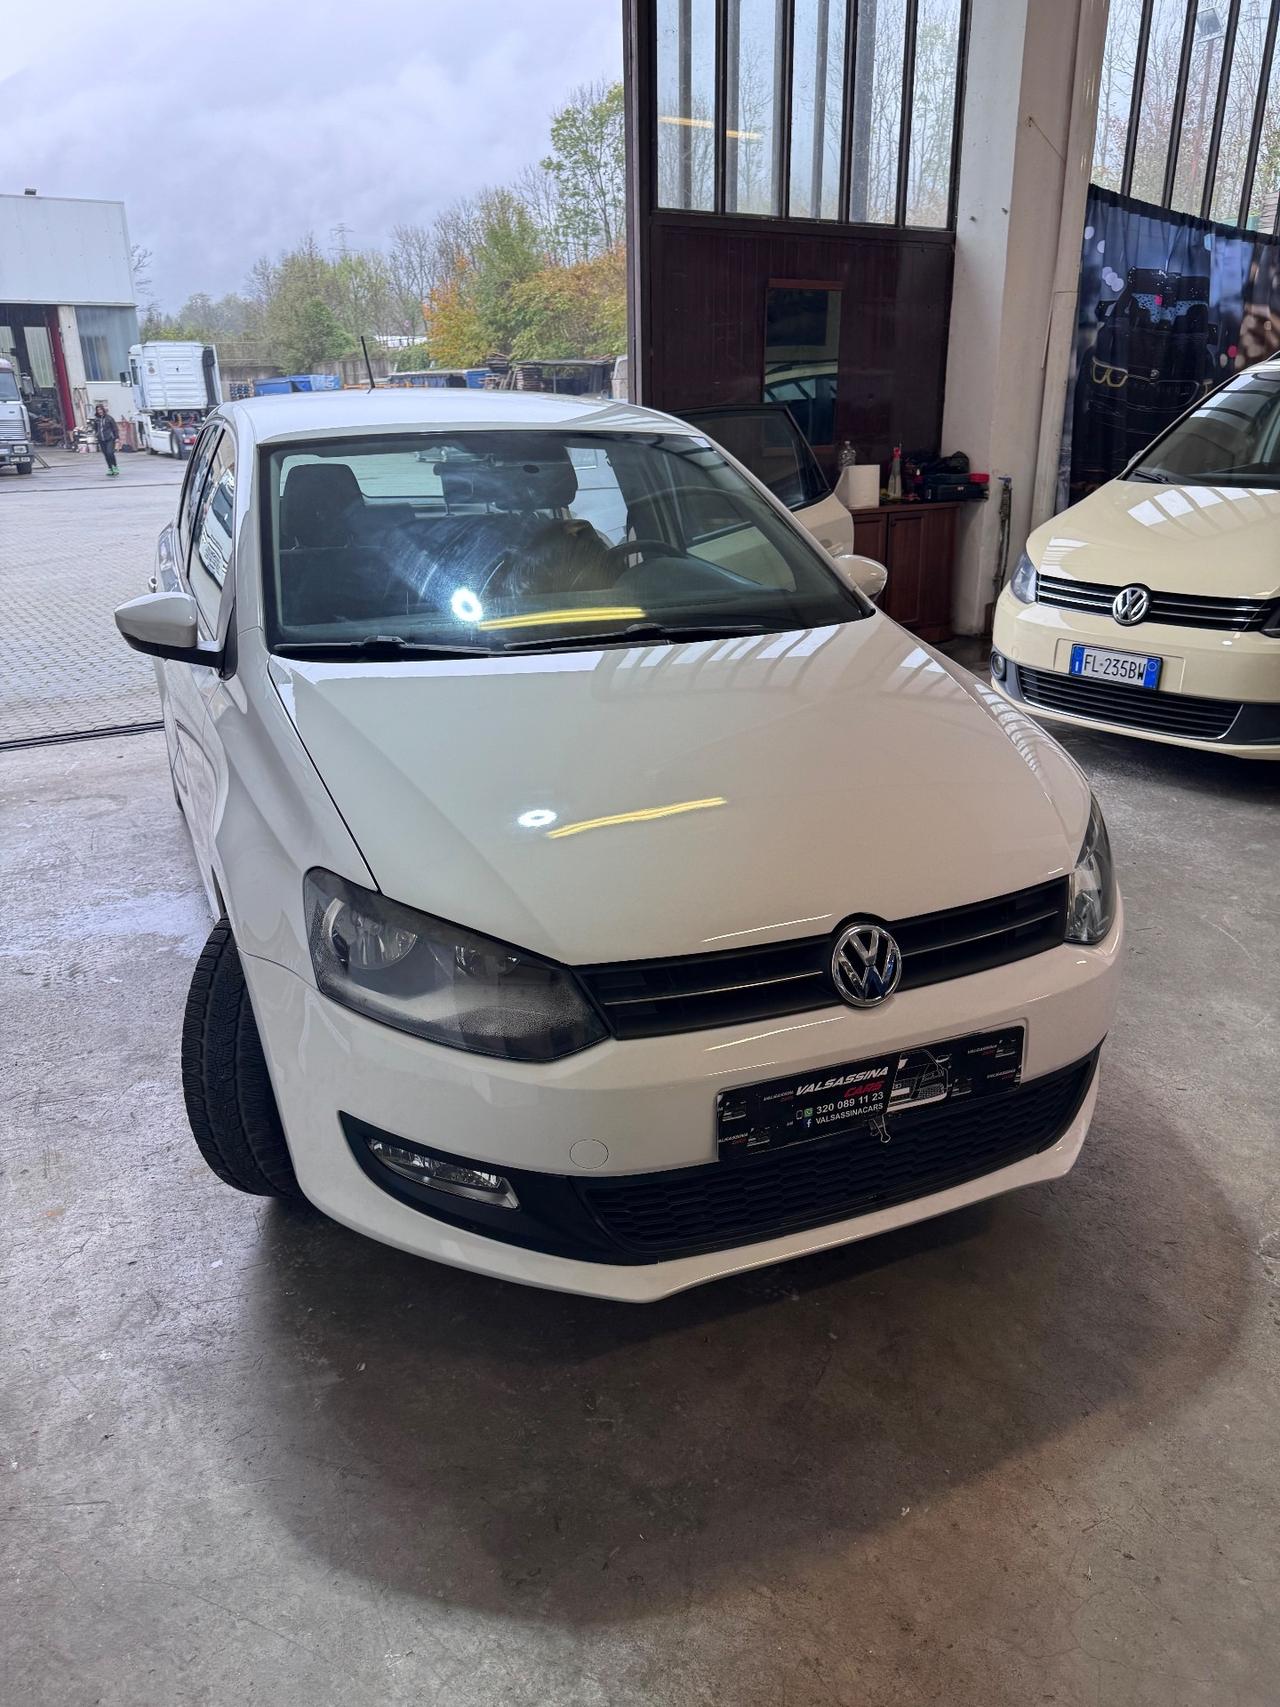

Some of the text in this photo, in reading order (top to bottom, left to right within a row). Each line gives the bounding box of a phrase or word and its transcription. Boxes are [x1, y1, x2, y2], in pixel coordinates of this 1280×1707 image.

[796, 1067, 888, 1096] VALSASSINA
[844, 1081, 885, 1098] CARS
[816, 1092, 884, 1115] 320 089 11 23
[816, 1103, 884, 1125] VALSASSINACARS
